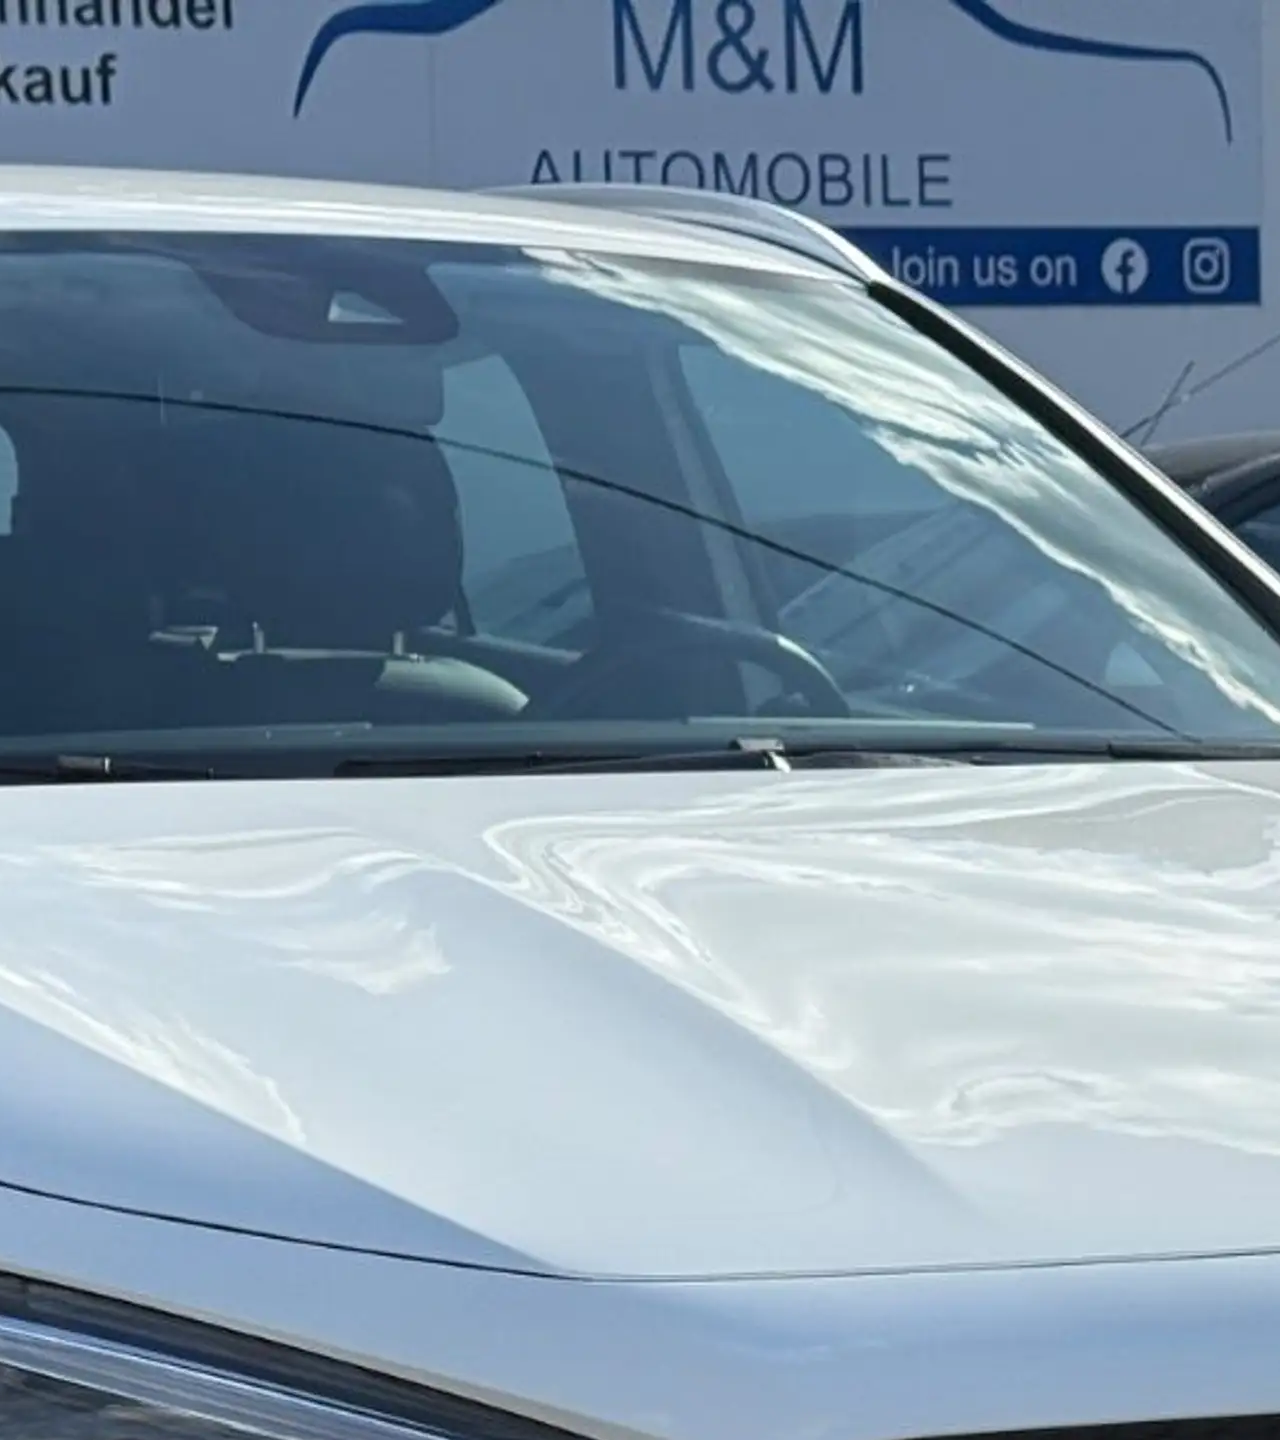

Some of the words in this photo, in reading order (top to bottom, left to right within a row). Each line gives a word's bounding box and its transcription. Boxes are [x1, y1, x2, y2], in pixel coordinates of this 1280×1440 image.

[612, 0, 865, 95] M&M
[529, 148, 953, 207] AUTOMOBILE
[973, 254, 1018, 287] us
[1029, 254, 1078, 287] on
